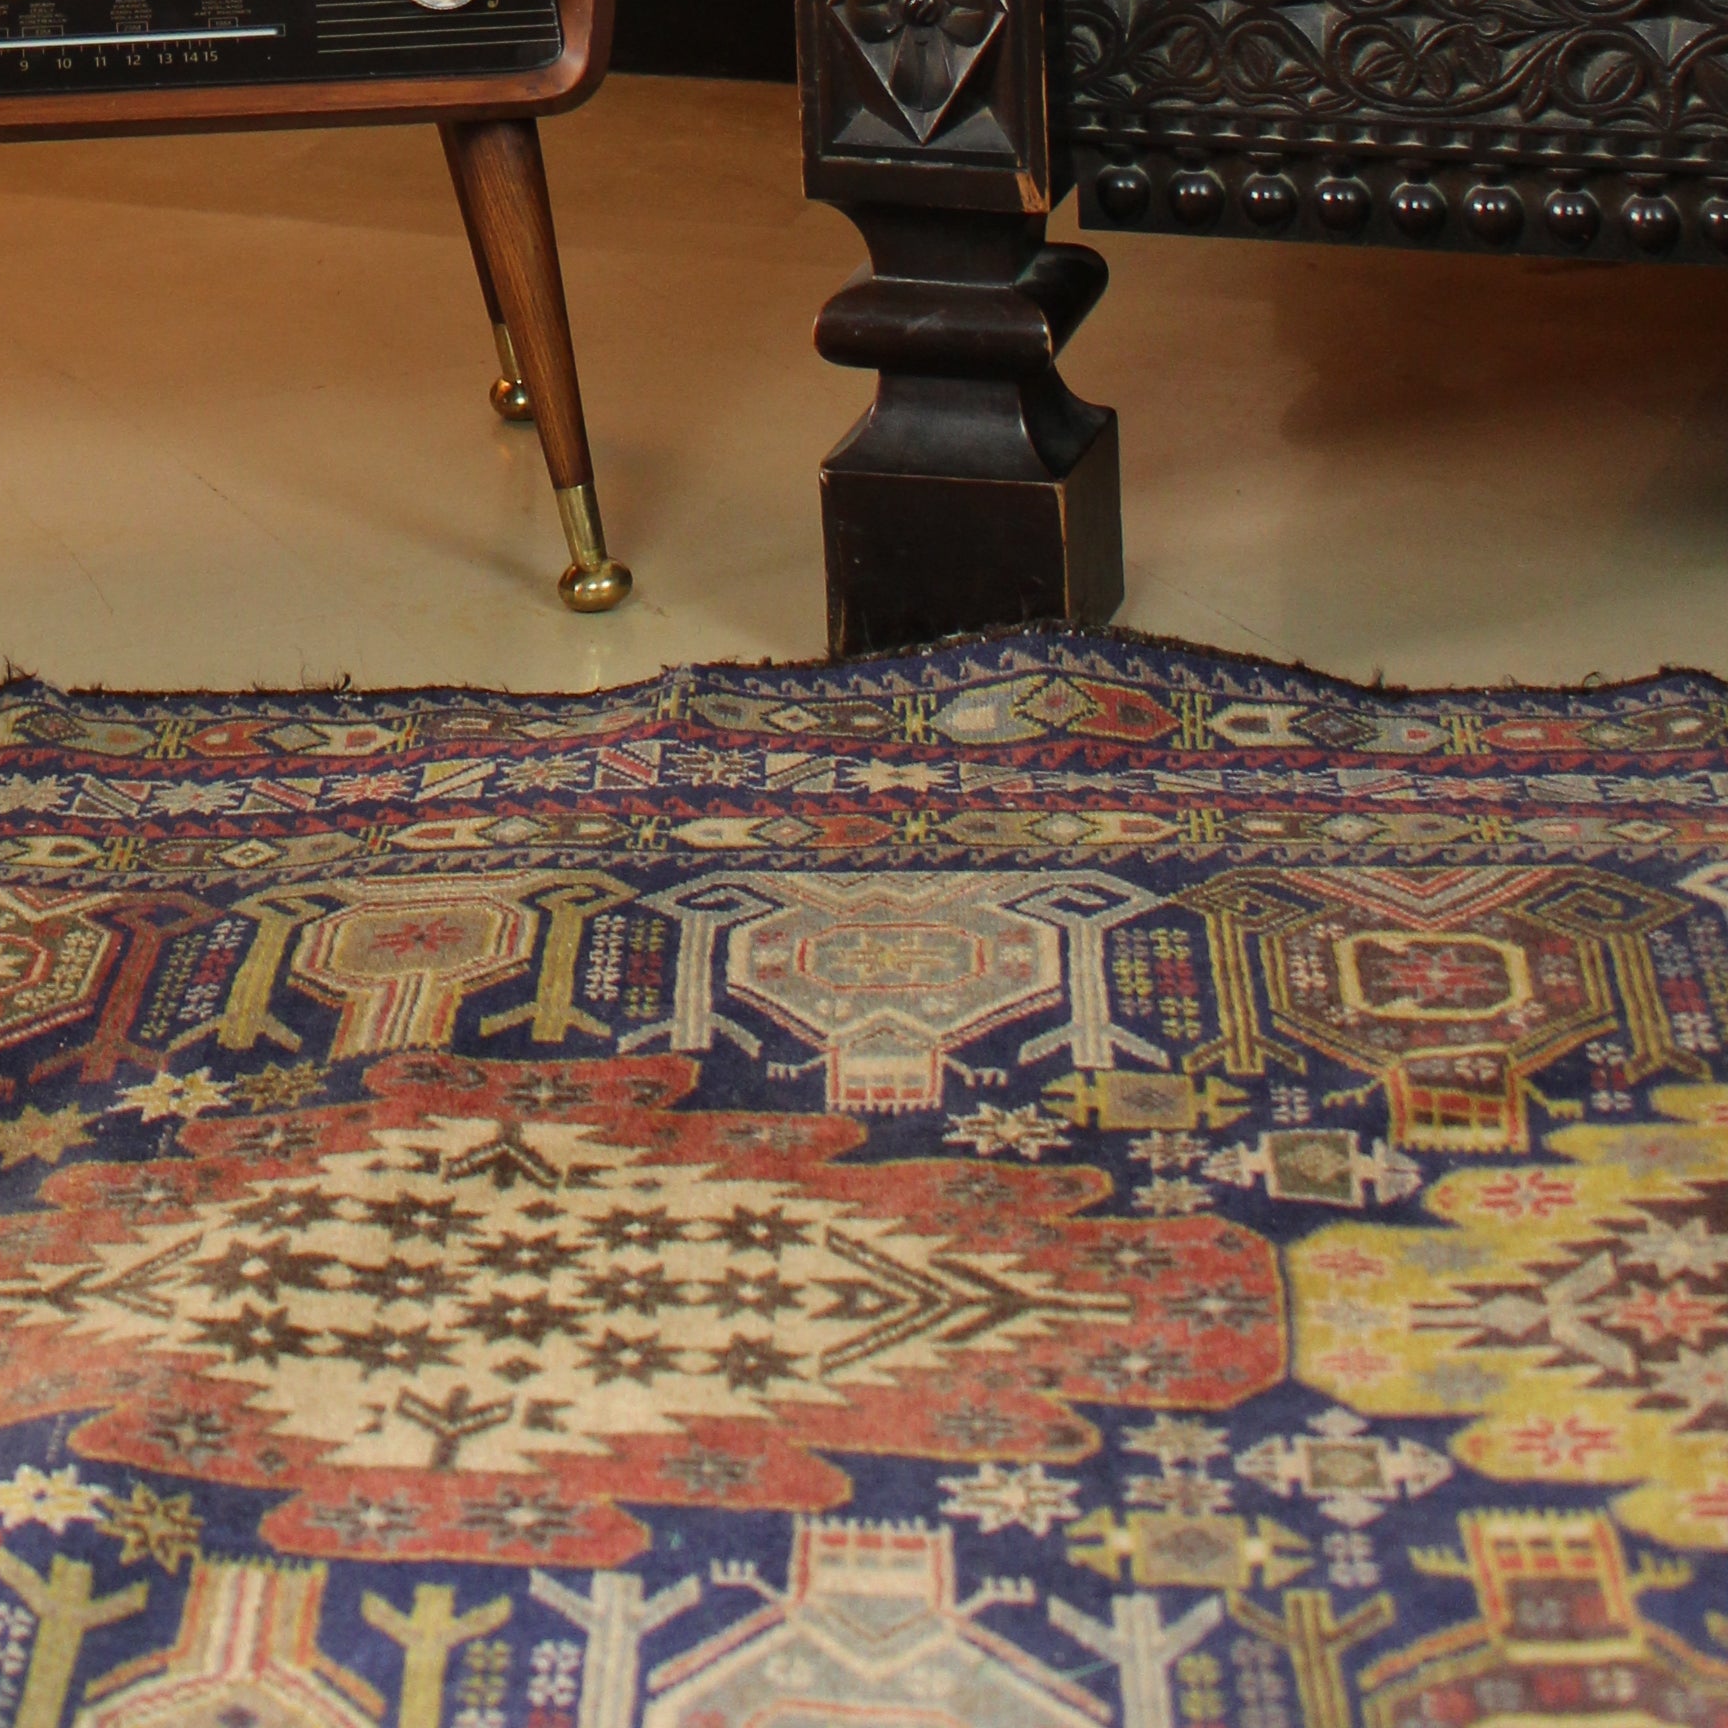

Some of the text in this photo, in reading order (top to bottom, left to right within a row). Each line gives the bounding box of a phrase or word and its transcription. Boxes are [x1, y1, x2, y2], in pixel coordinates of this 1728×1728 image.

[20, 60, 29, 71] 9
[57, 58, 72, 69] 10
[95, 56, 107, 67] 11
[127, 54, 141, 65] 12
[158, 53, 173, 64] 13
[184, 52, 198, 63] 14
[203, 51, 218, 62] 15
